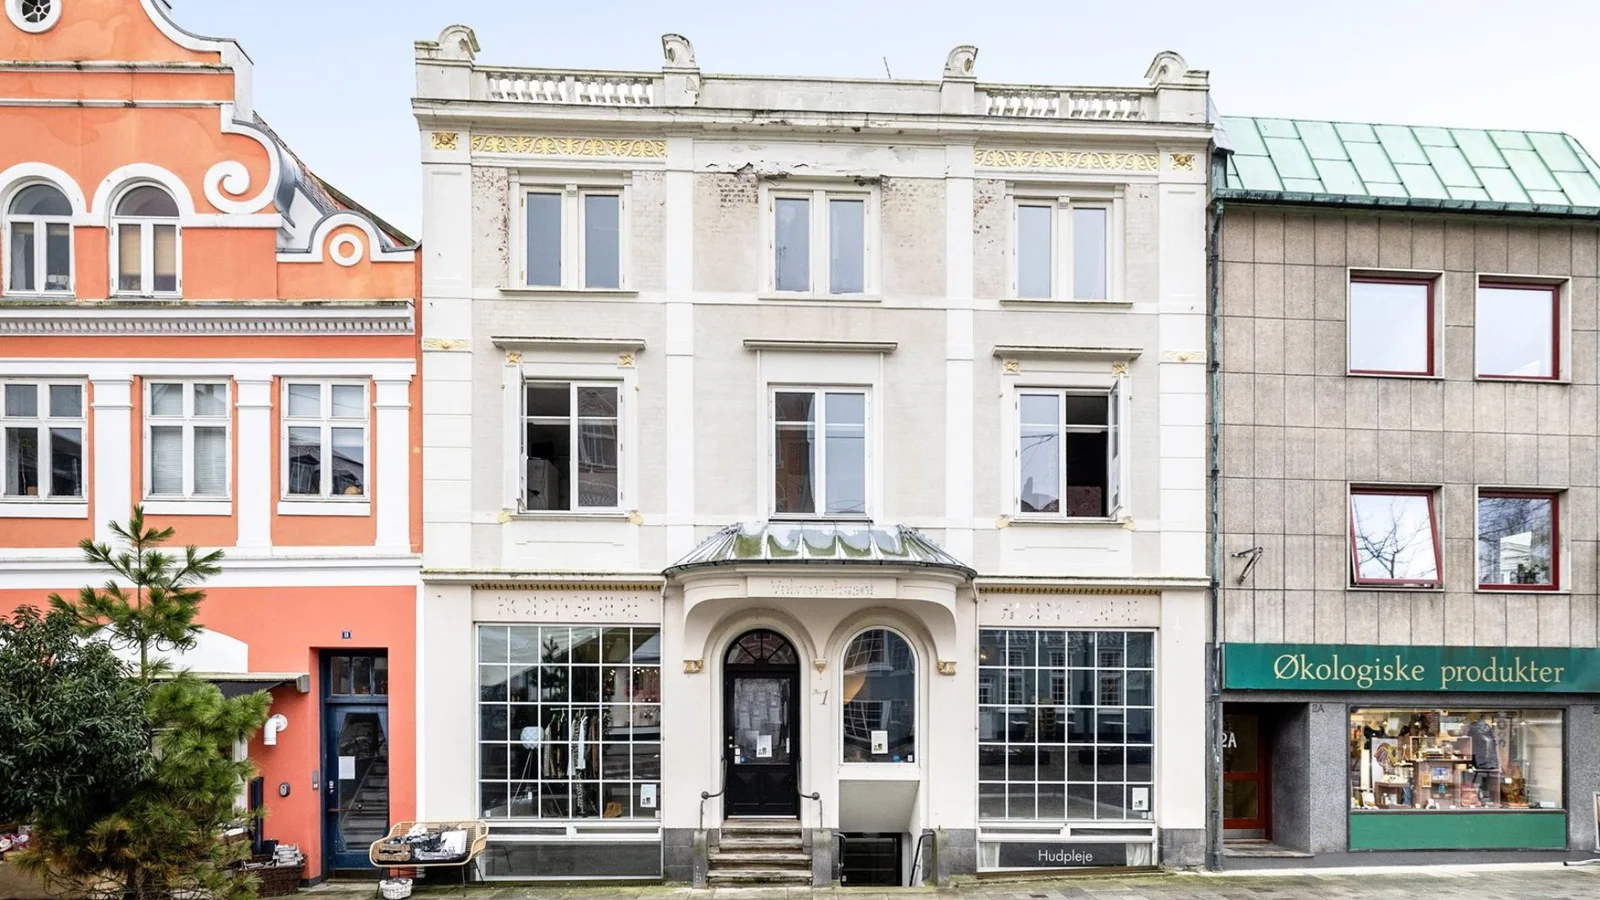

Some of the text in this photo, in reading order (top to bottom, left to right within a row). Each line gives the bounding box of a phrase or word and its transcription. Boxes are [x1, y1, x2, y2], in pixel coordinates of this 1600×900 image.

[1273, 653, 1565, 690] Økologiske produkter
[1312, 703, 1325, 713] 2A
[1220, 732, 1238, 749] 2A
[1038, 849, 1093, 865] Hudpleje
